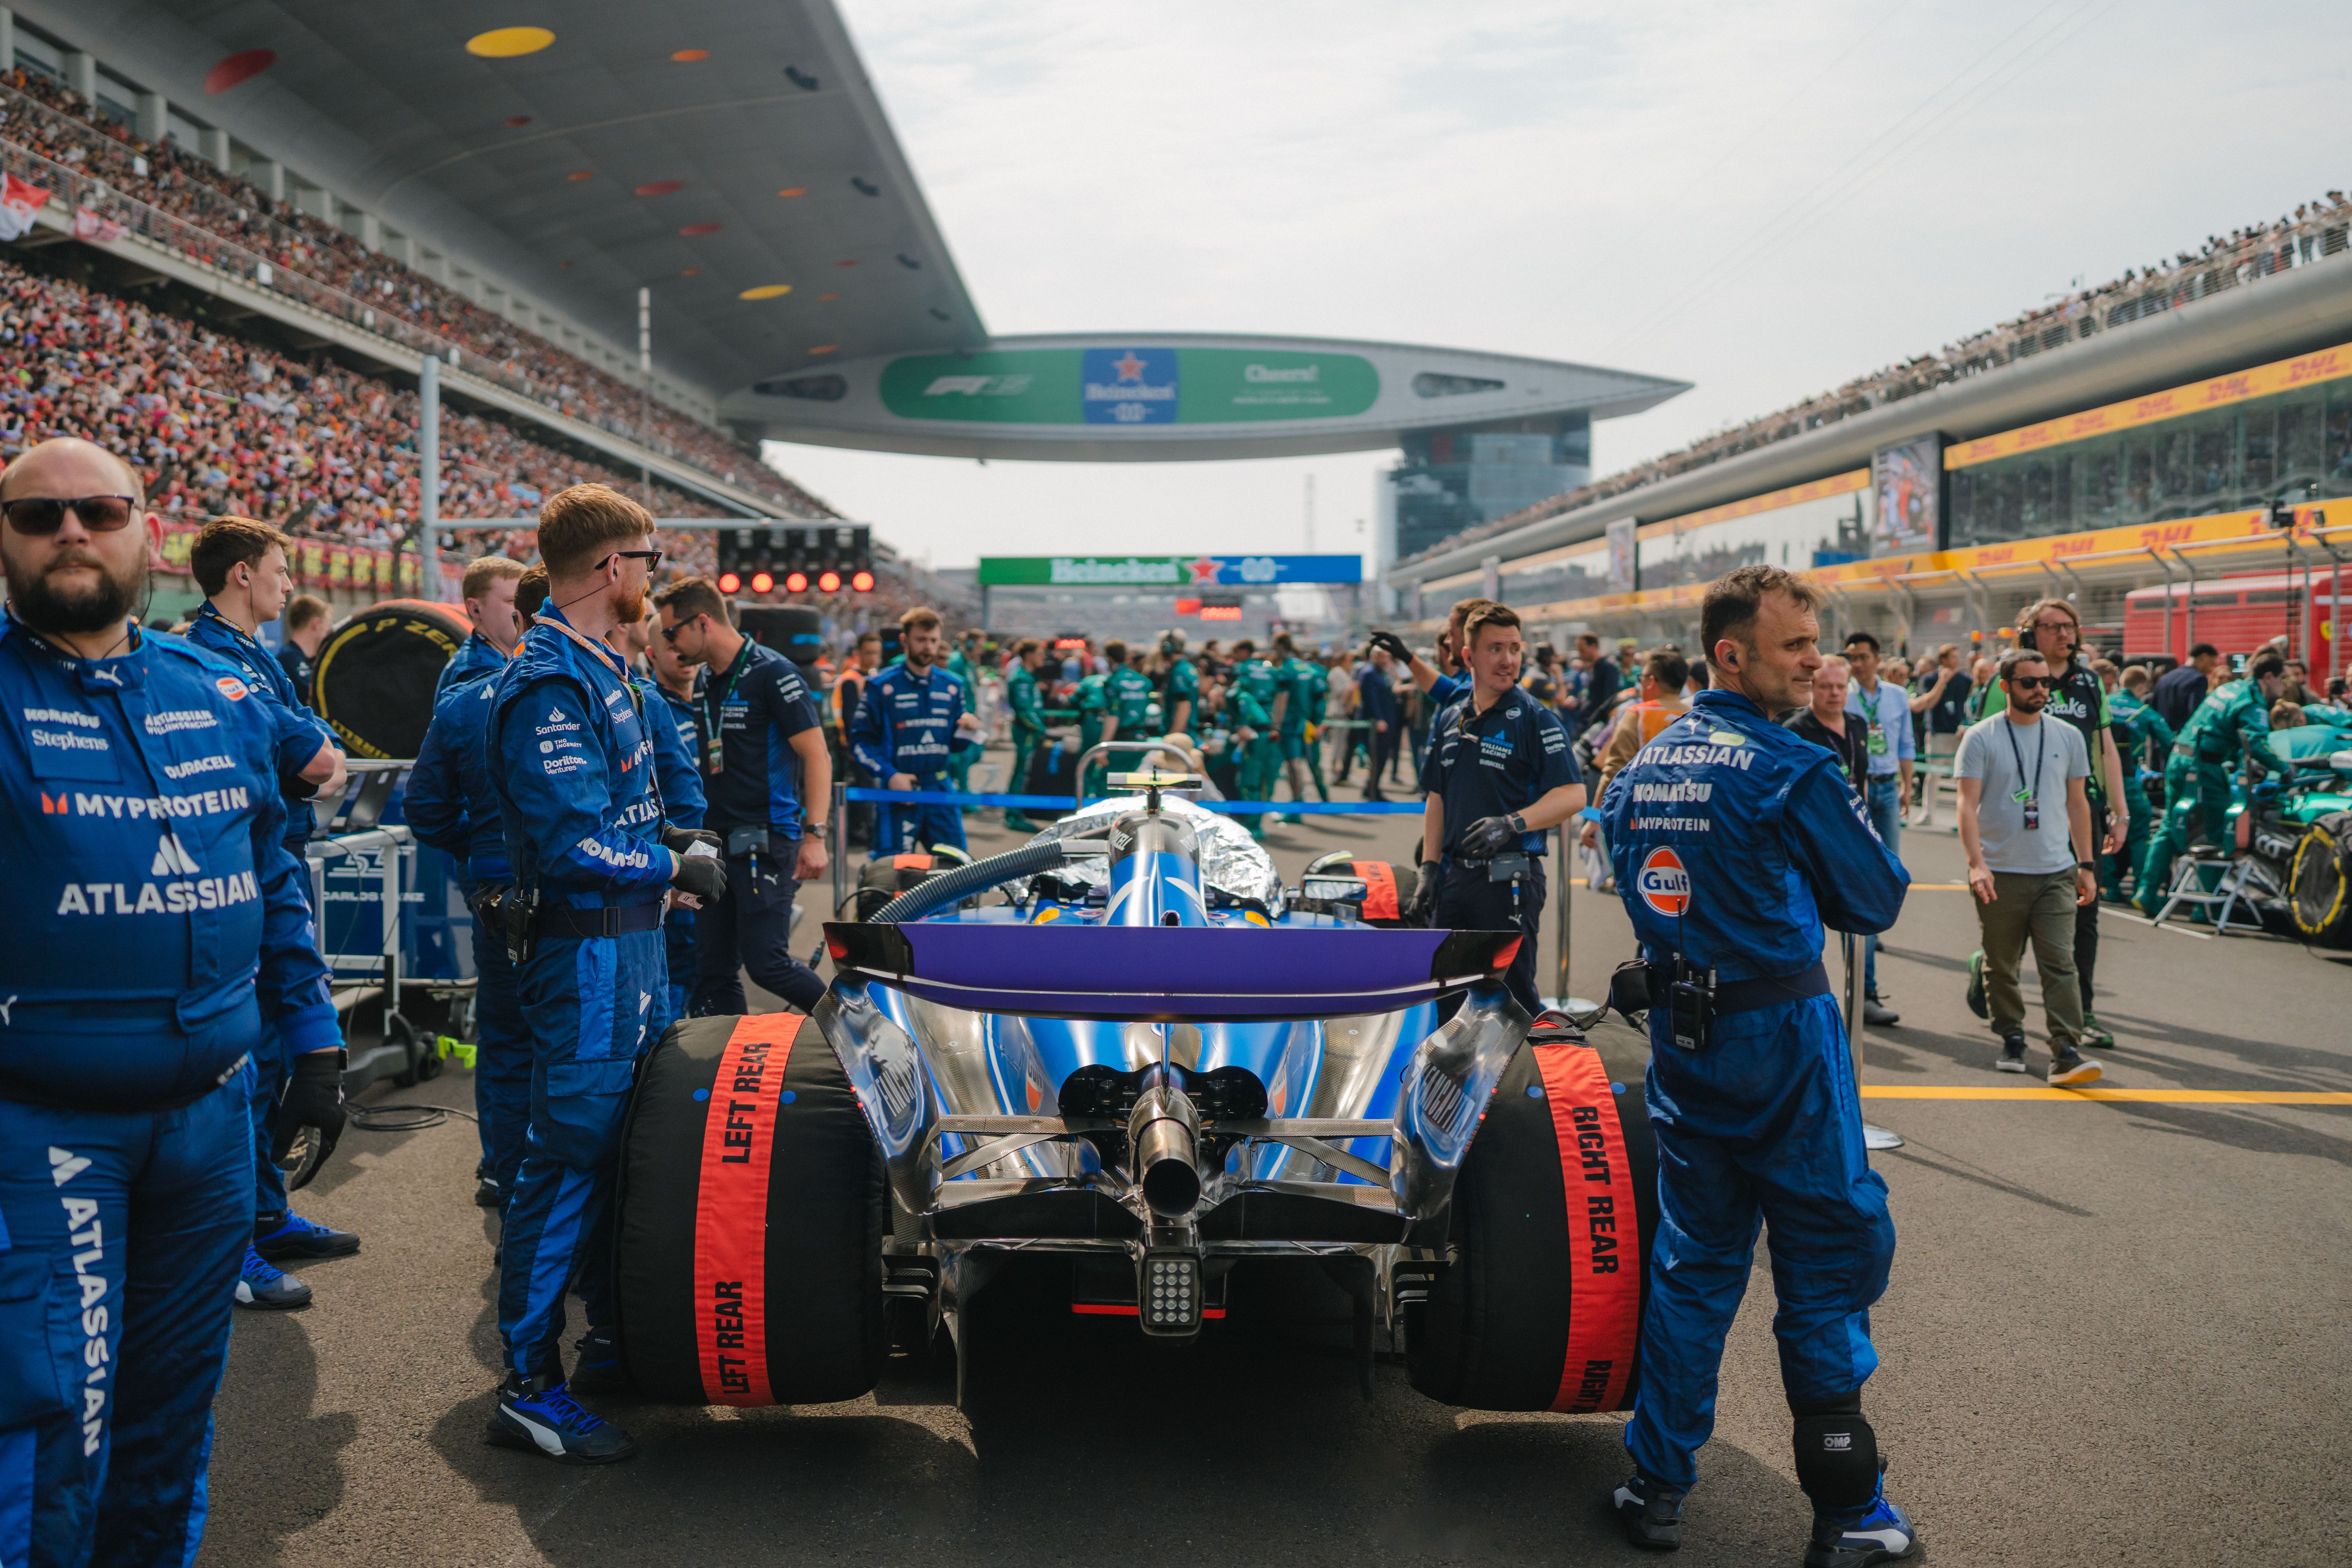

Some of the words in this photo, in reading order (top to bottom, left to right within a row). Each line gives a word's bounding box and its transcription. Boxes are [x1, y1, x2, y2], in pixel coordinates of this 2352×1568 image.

[1050, 558, 1180, 583] Heineken
[604, 689, 622, 707] KOMATSU
[24, 708, 101, 729] KOMATSU
[153, 710, 214, 726] ATLASSIAN
[612, 708, 633, 724] Stephens
[31, 729, 109, 751] Stephens
[535, 722, 581, 735] Santander
[1480, 742, 1512, 755] WILLIAMS
[1481, 747, 1506, 759] RACING
[1639, 745, 1755, 771] ATLASSIAN
[164, 755, 236, 779] DURACELL
[545, 766, 577, 775] Ventures
[1632, 778, 1713, 802] KOMATSU
[75, 787, 249, 820] MYPROTEIN
[1638, 817, 1710, 831] MYPROTEIN
[576, 837, 649, 869] KOMATSU
[57, 870, 258, 915] ATLASSIAN
[1643, 871, 1687, 891] Gulf
[733, 1043, 771, 1093] REAR
[722, 1100, 756, 1164] LEFT
[1572, 1106, 1611, 1185] RIGHT
[1587, 1196, 1619, 1274] REAR
[715, 1281, 745, 1349] REAR
[60, 1197, 110, 1458] ATLASSIAN
[719, 1355, 751, 1394] LEFT
[1575, 1360, 1613, 1405] RIGHT
[1824, 1436, 1851, 1448] OMP
